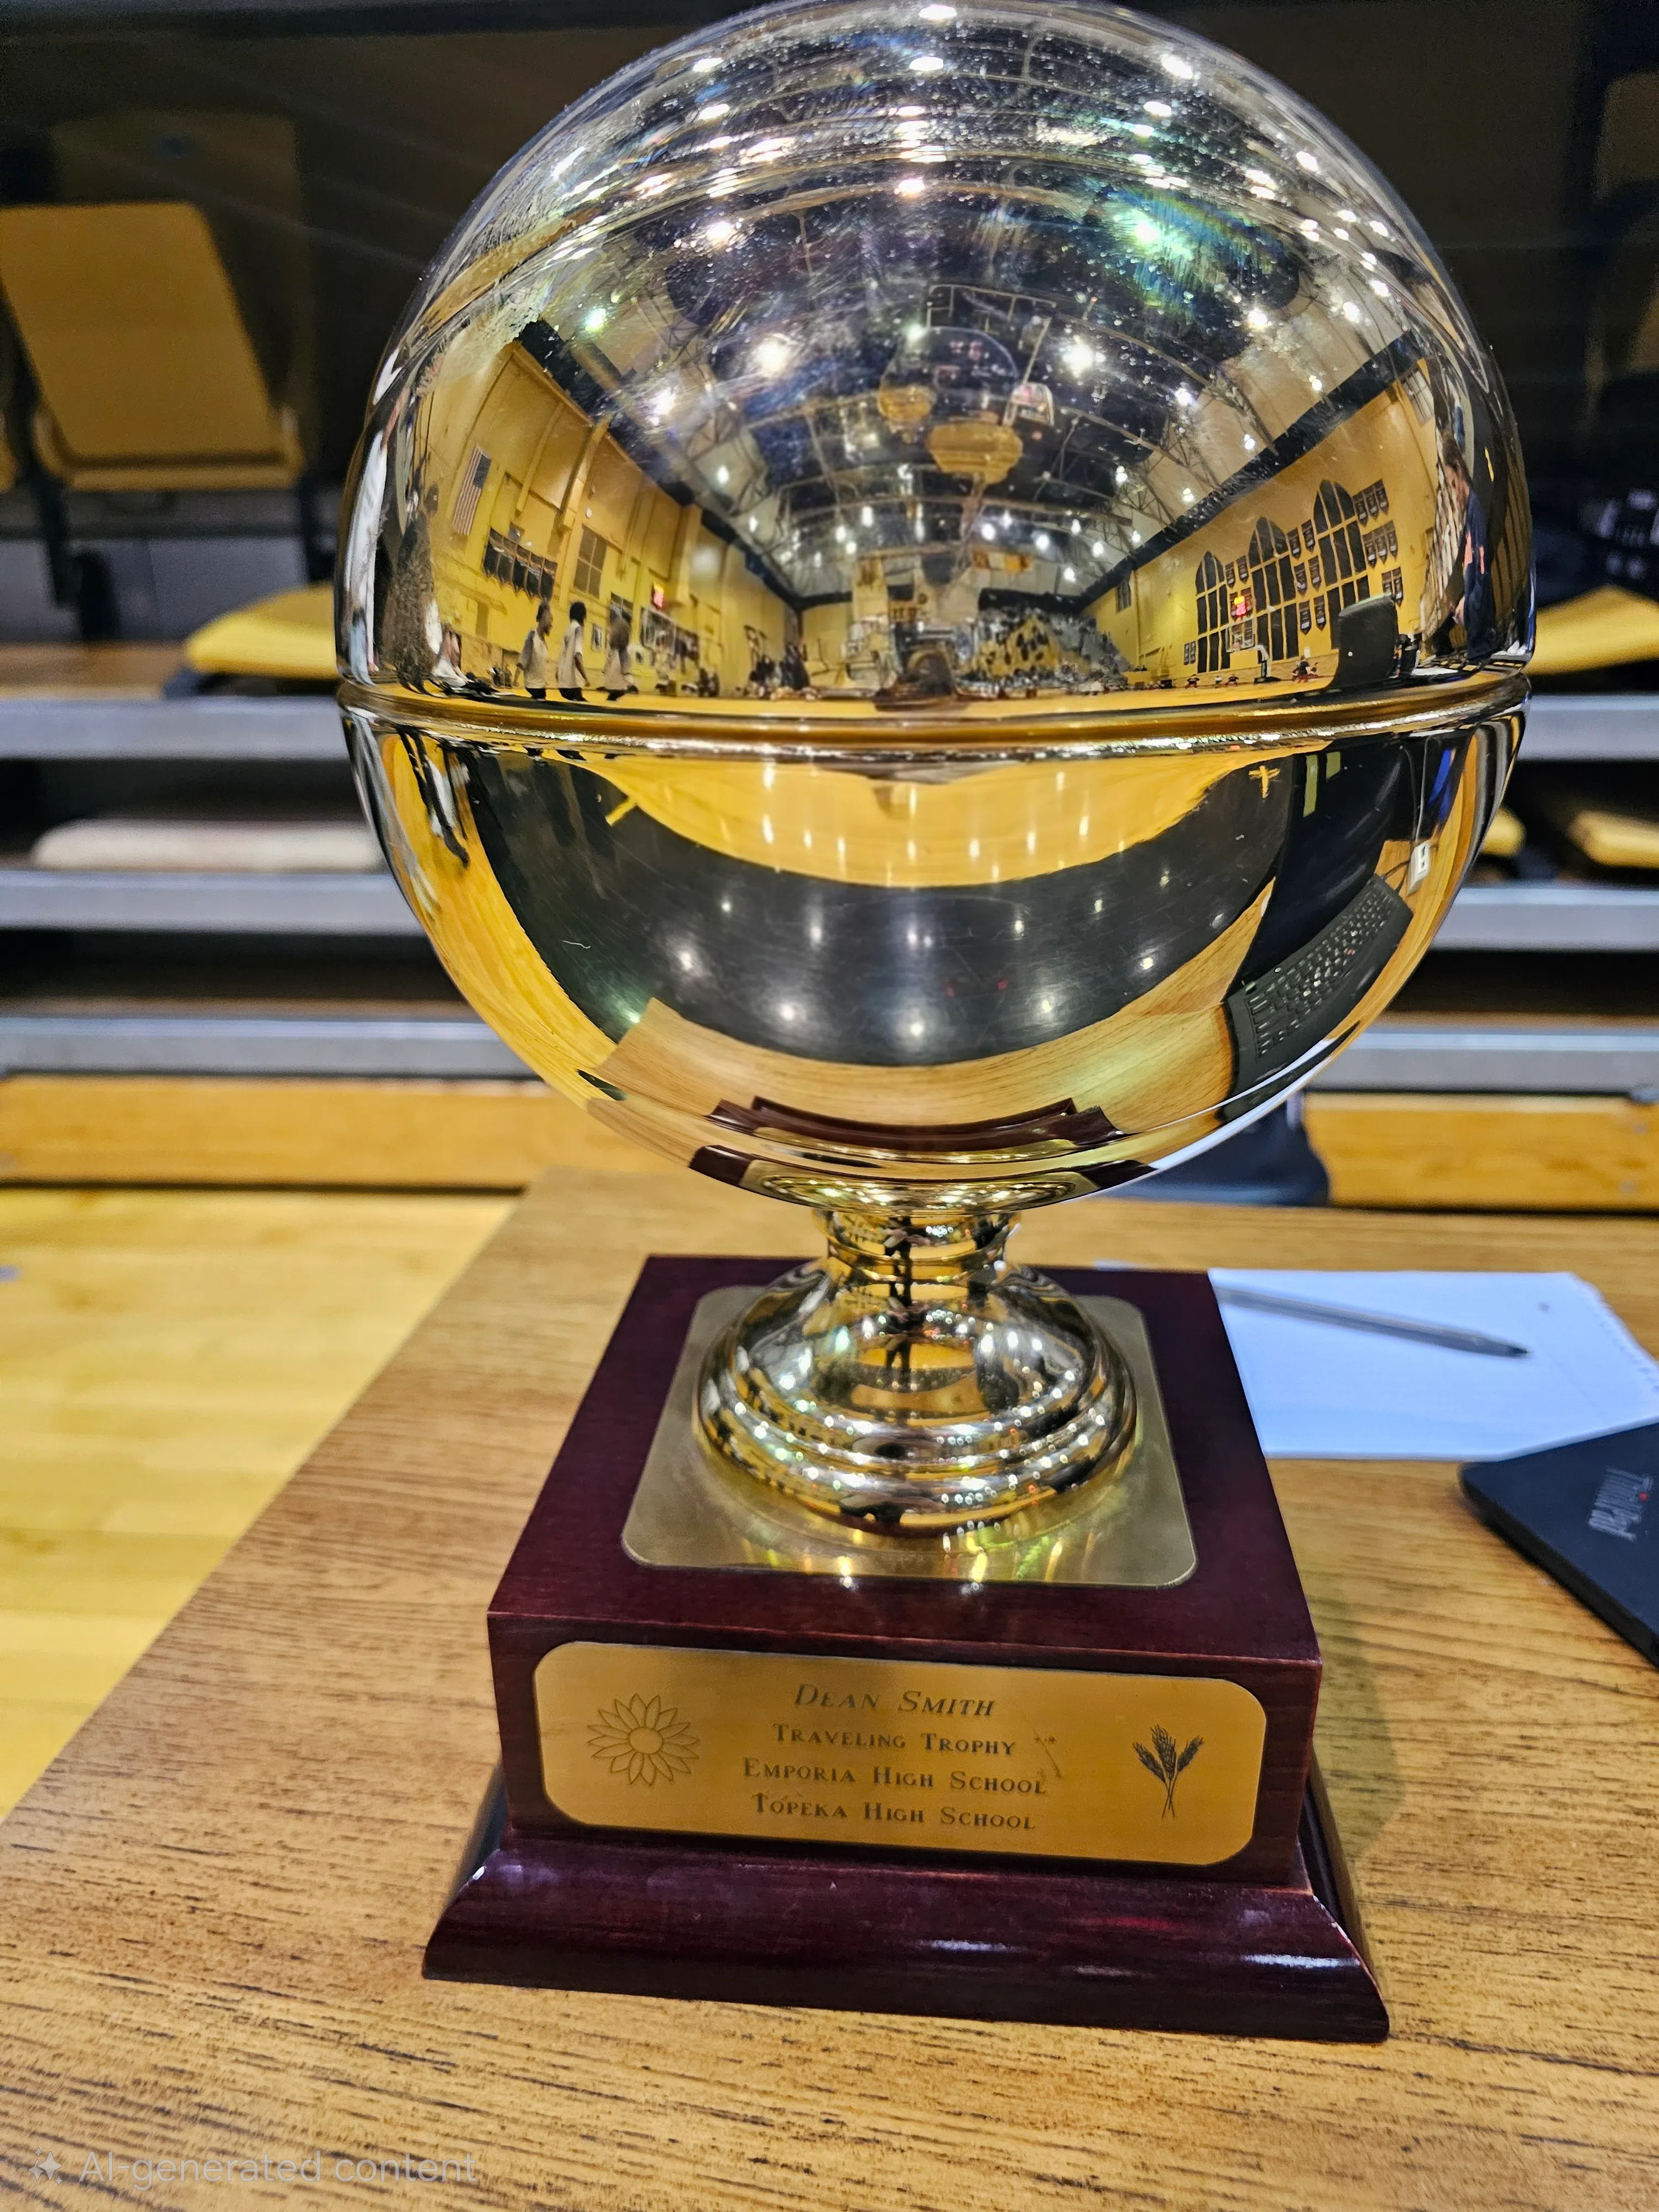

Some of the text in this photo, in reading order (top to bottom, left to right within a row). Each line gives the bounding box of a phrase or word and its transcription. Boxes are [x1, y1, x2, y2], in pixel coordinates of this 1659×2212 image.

[794, 1683, 995, 1716] DEAN SMITH
[771, 1722, 1016, 1755] TRAVELING TROPHY
[743, 1757, 1047, 1794] EMPORIA HIGH SCHOOL
[751, 1792, 1036, 1830] TOPEKA HIGH SCHOOL
